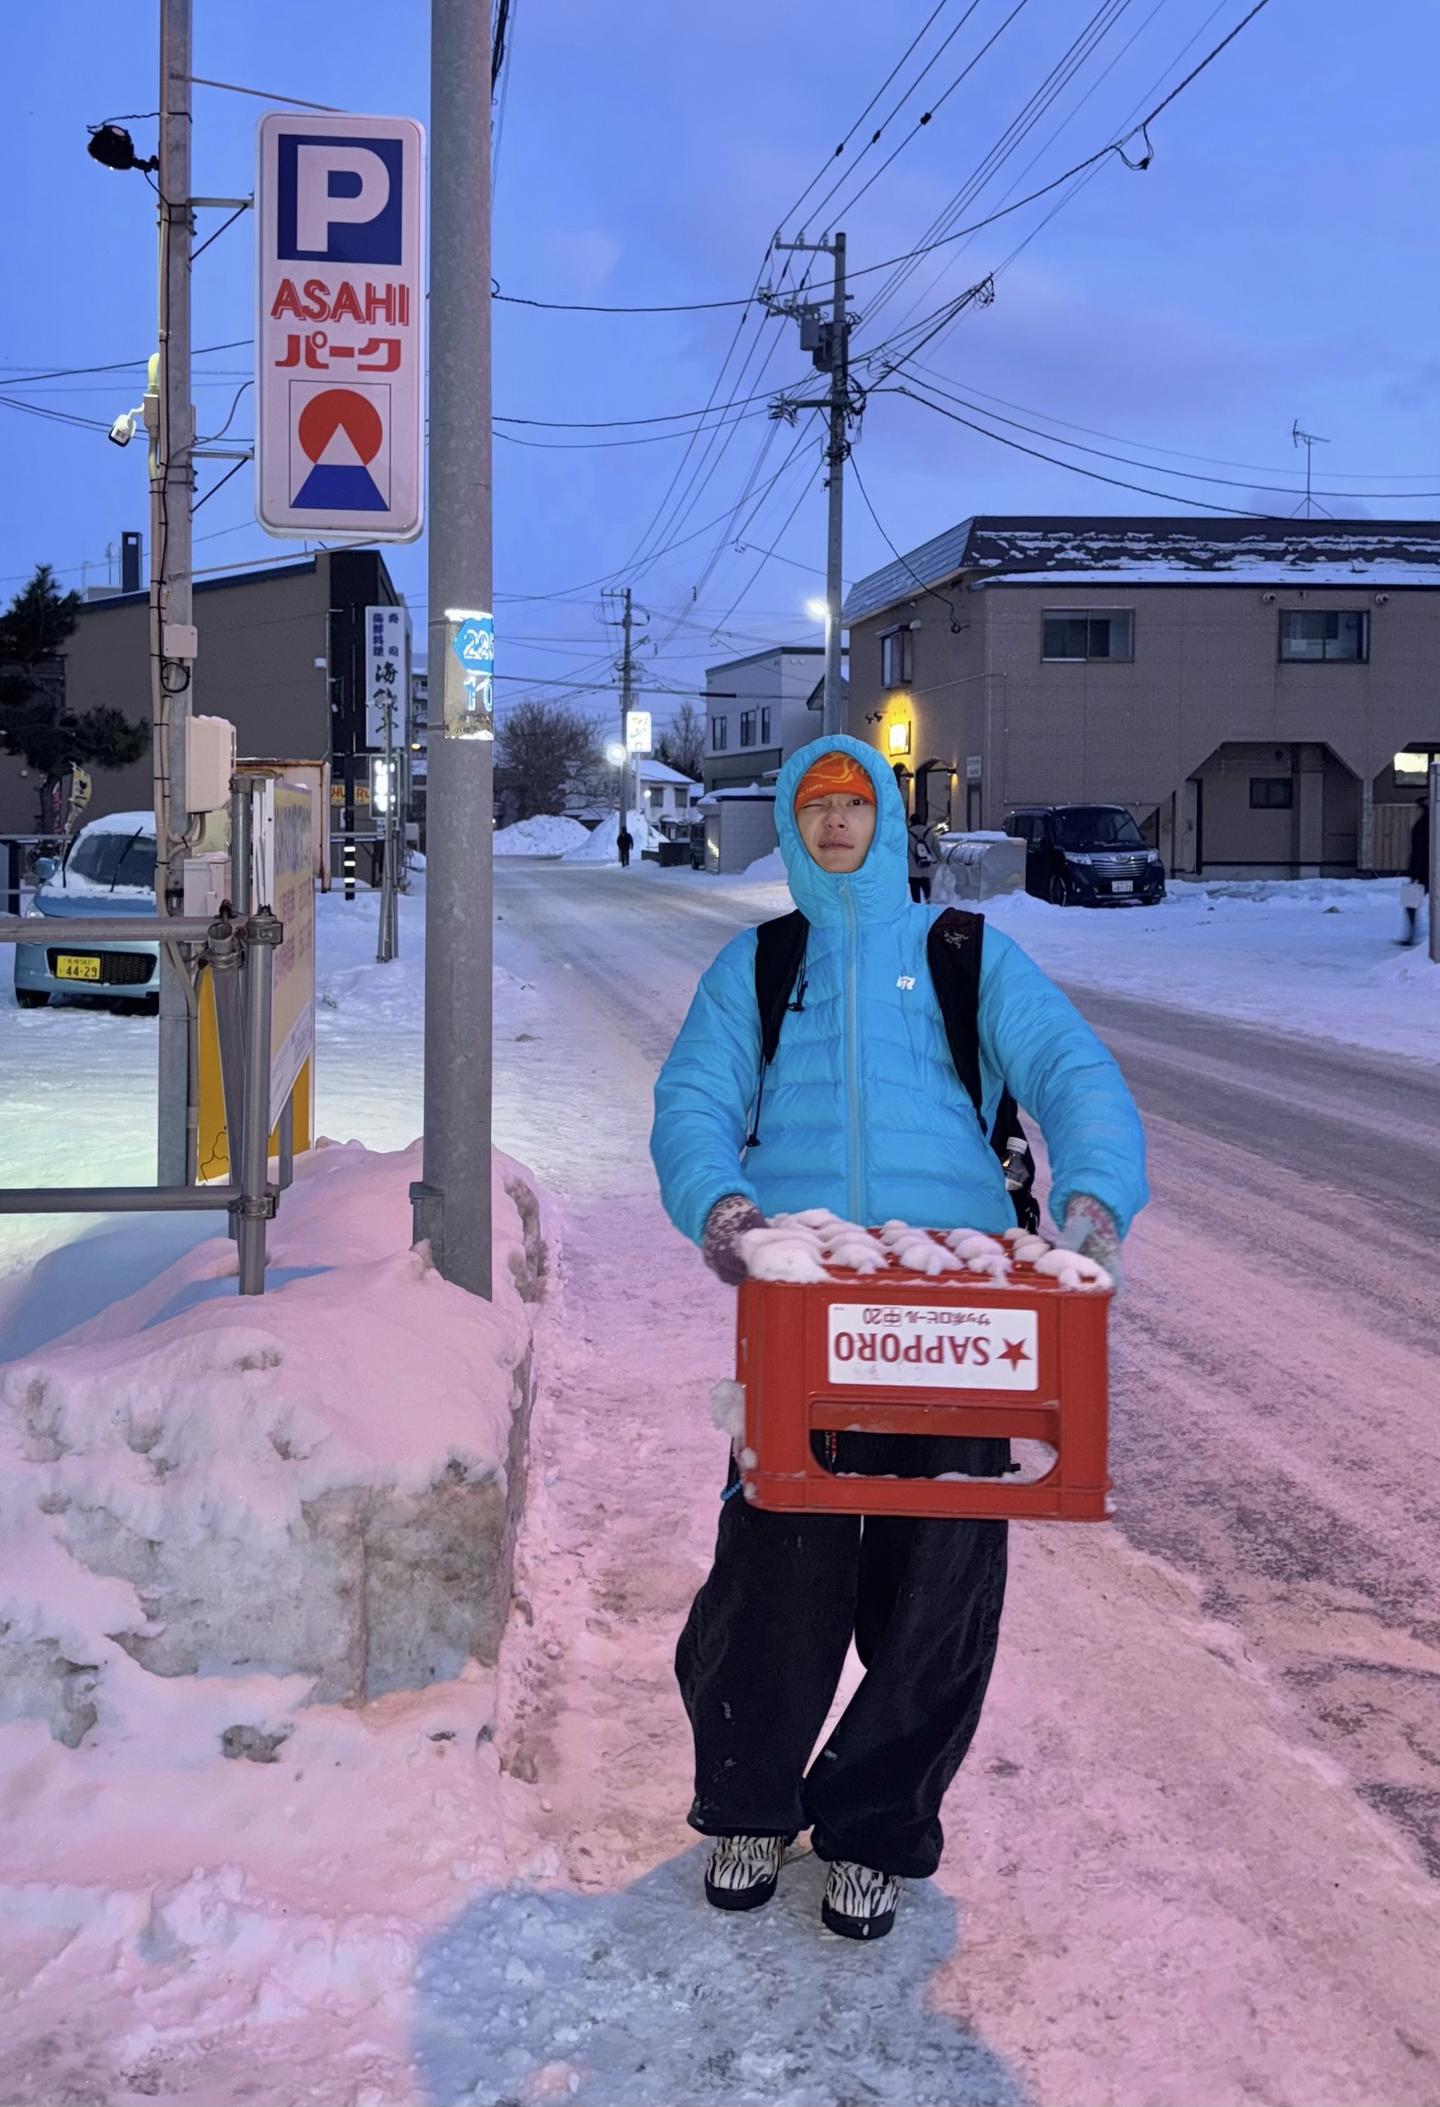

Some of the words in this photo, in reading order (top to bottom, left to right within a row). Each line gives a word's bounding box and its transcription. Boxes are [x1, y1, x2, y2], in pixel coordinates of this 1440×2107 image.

[296, 144, 390, 253] P
[270, 278, 409, 327] ASAHI
[274, 330, 402, 373] パーク
[66, 965, 98, 978] 44-29
[834, 1331, 991, 1366] SAPPORO
